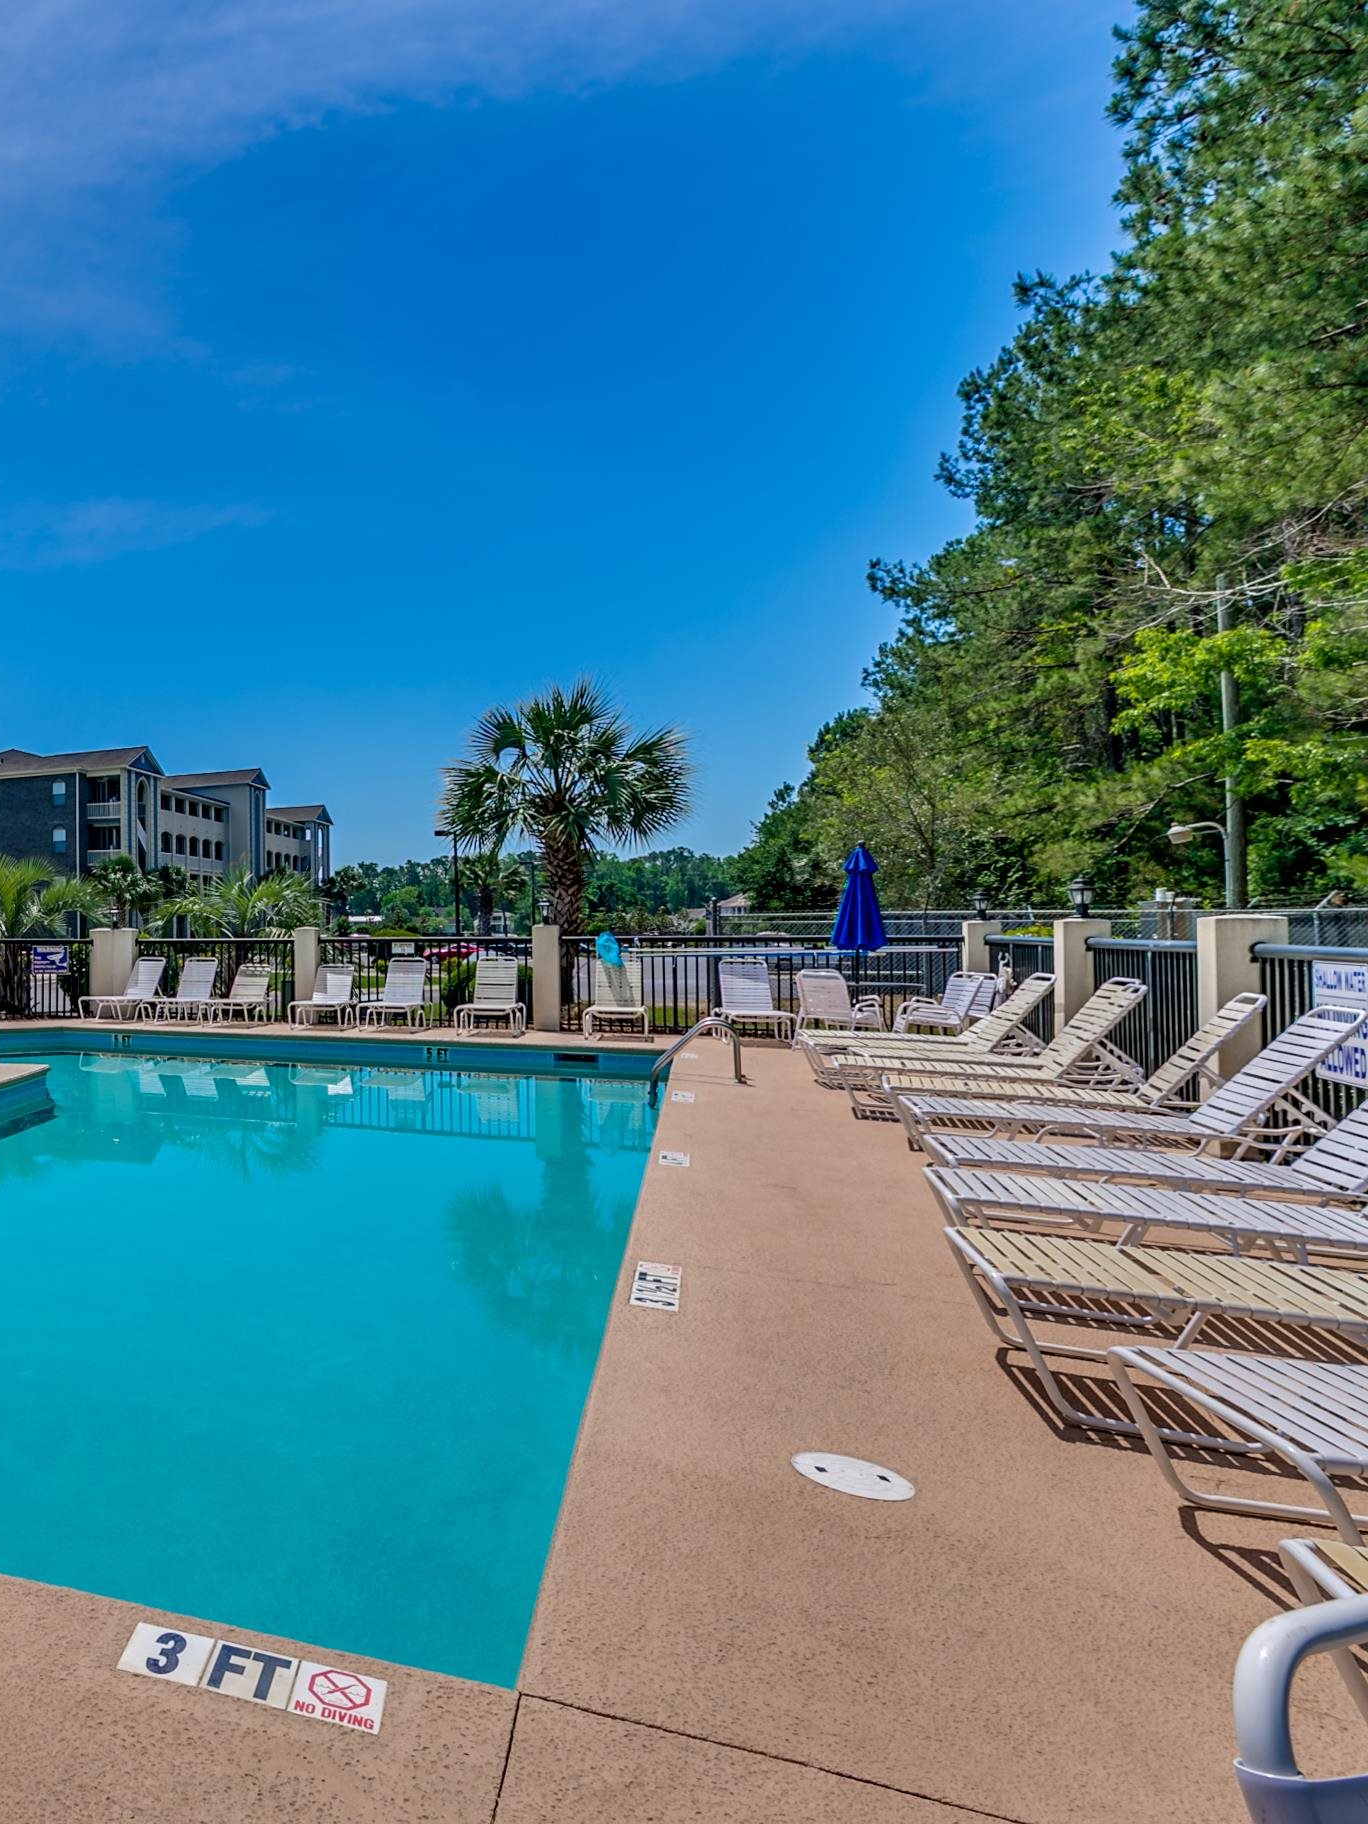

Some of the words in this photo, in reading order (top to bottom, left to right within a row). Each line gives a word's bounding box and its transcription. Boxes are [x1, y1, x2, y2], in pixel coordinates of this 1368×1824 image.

[638, 1272, 678, 1286] FT
[146, 1632, 187, 1675] 3
[206, 1643, 292, 1701] FT
[293, 1699, 316, 1715] NO
[320, 1706, 374, 1730] DIVING
